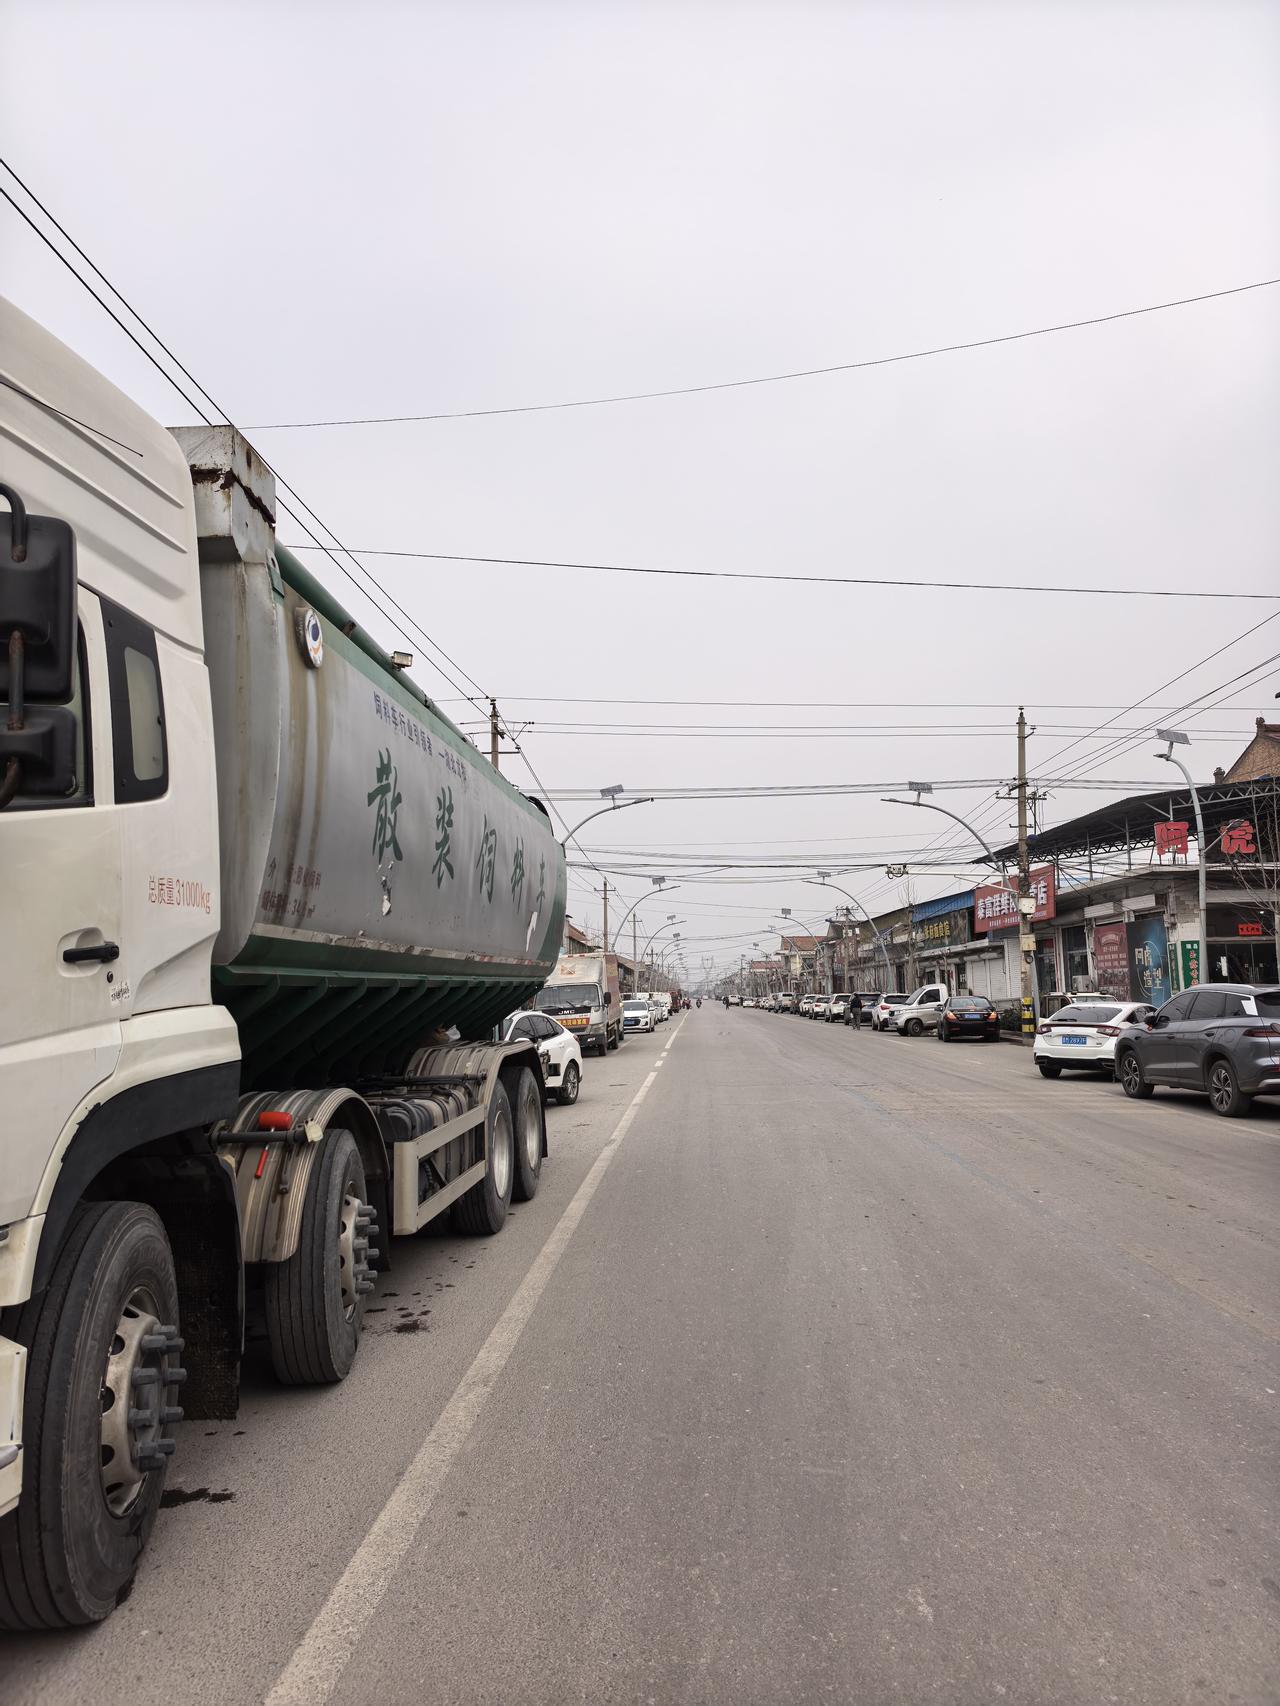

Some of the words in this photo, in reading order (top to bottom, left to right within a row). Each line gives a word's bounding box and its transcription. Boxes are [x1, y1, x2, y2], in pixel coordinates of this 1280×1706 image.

[367, 747, 546, 917] 散装饲料车
[148, 876, 211, 915] 总质量31000kg
